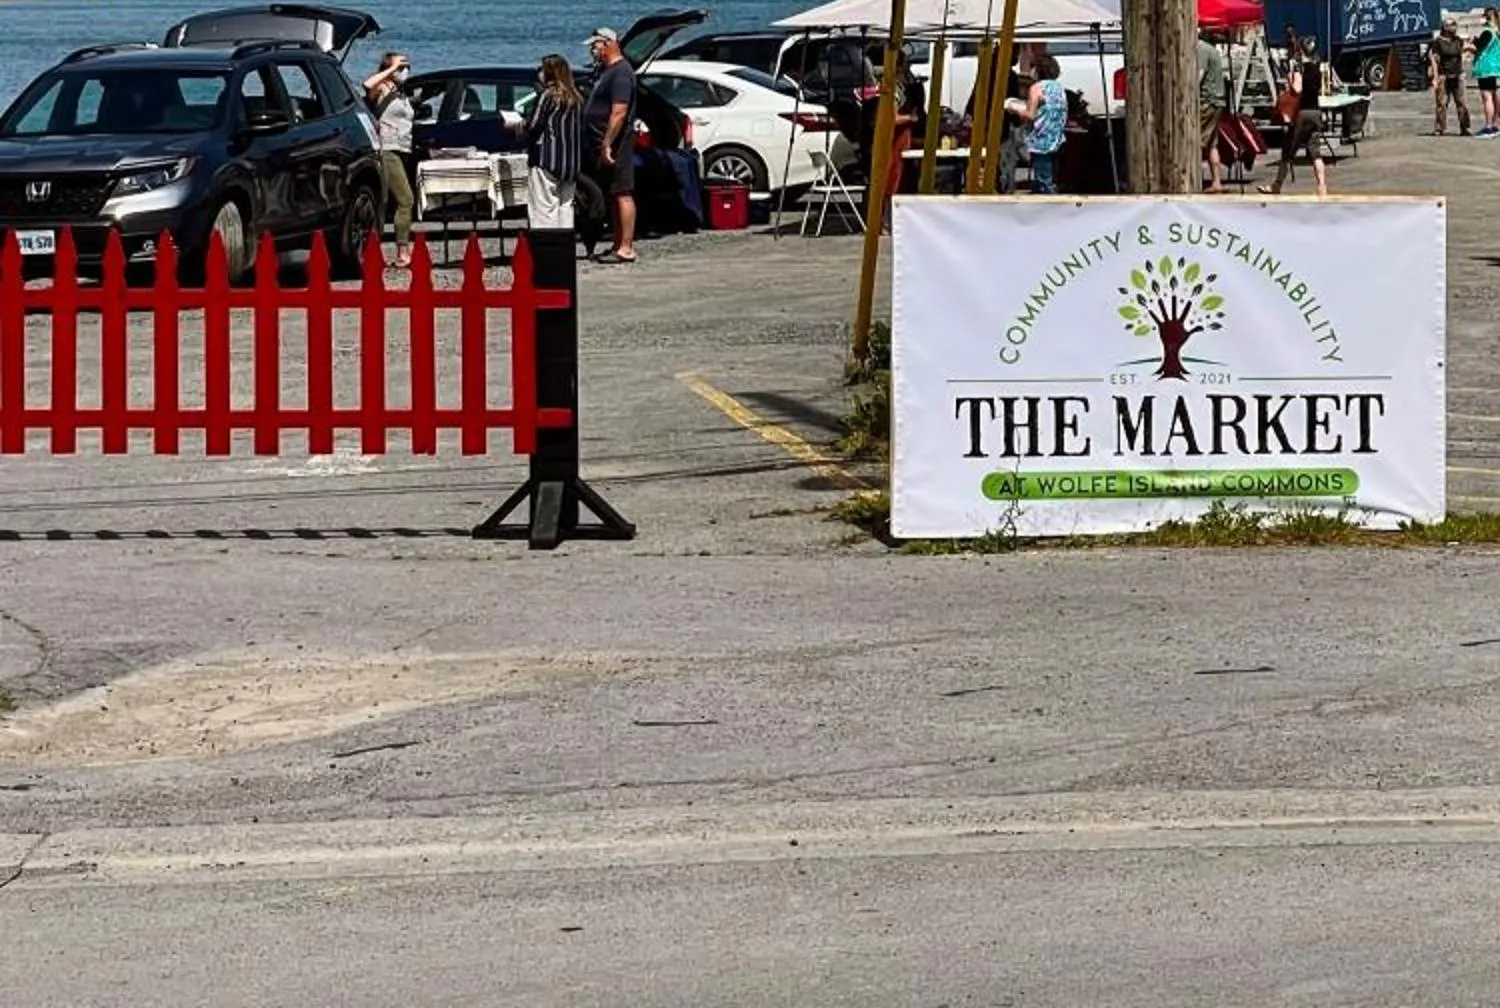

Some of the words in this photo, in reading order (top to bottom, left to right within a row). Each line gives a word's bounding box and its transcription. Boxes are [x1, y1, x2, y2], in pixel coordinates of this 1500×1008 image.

[1000, 231, 1121, 365] COMMUNITY
[1137, 225, 1153, 245] &
[1169, 223, 1344, 365] SUSTAINABILITY
[1199, 373, 1232, 385] 2021
[955, 395, 1092, 458] THE
[1112, 393, 1385, 457] MARKET
[999, 477, 1027, 495] AT
[1037, 475, 1117, 493] WOLFE
[1222, 473, 1344, 492] COMMONS
